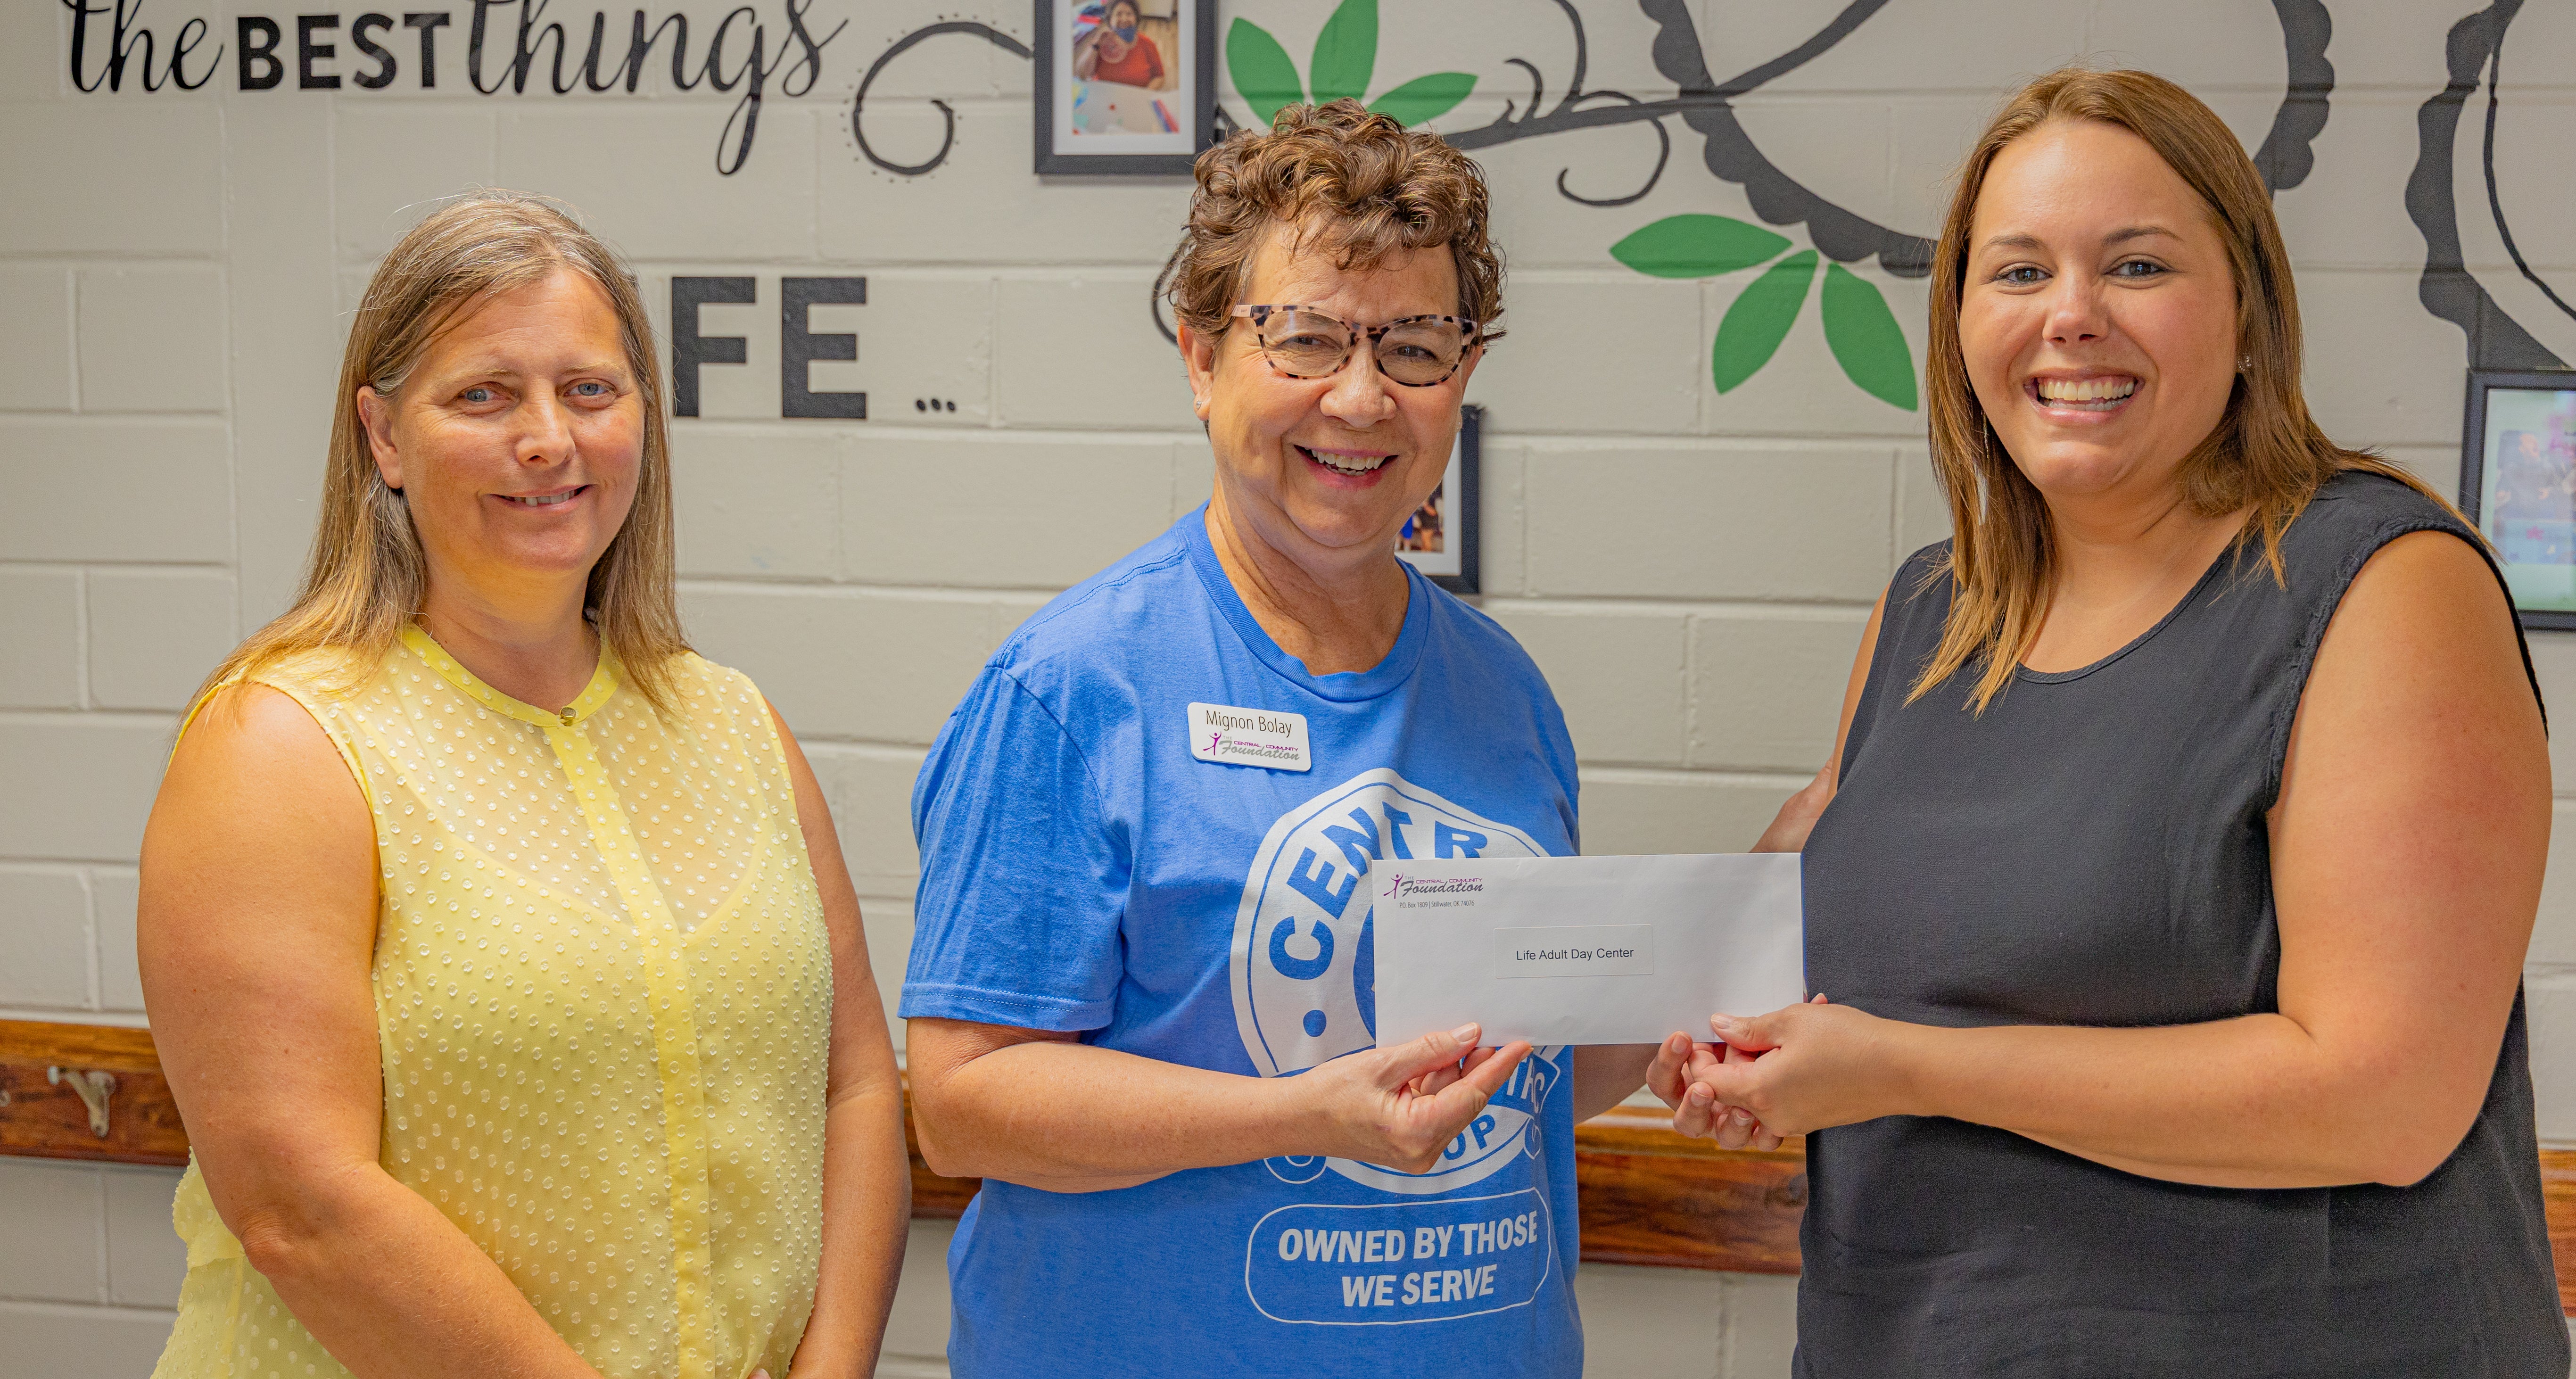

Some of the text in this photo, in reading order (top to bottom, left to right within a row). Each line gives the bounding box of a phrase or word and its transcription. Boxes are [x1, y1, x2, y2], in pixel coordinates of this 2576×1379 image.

[62, 0, 849, 176] the BEST things
[1205, 710, 1292, 738] Mignon Bolay
[1219, 740, 1300, 760] Foundation
[1400, 880, 1484, 897] Foundation
[1516, 948, 1634, 961] Life Adult Day Center
[1278, 1210, 1538, 1263] OWNED BY THOSE
[1342, 1264, 1498, 1307] WE SERVE
